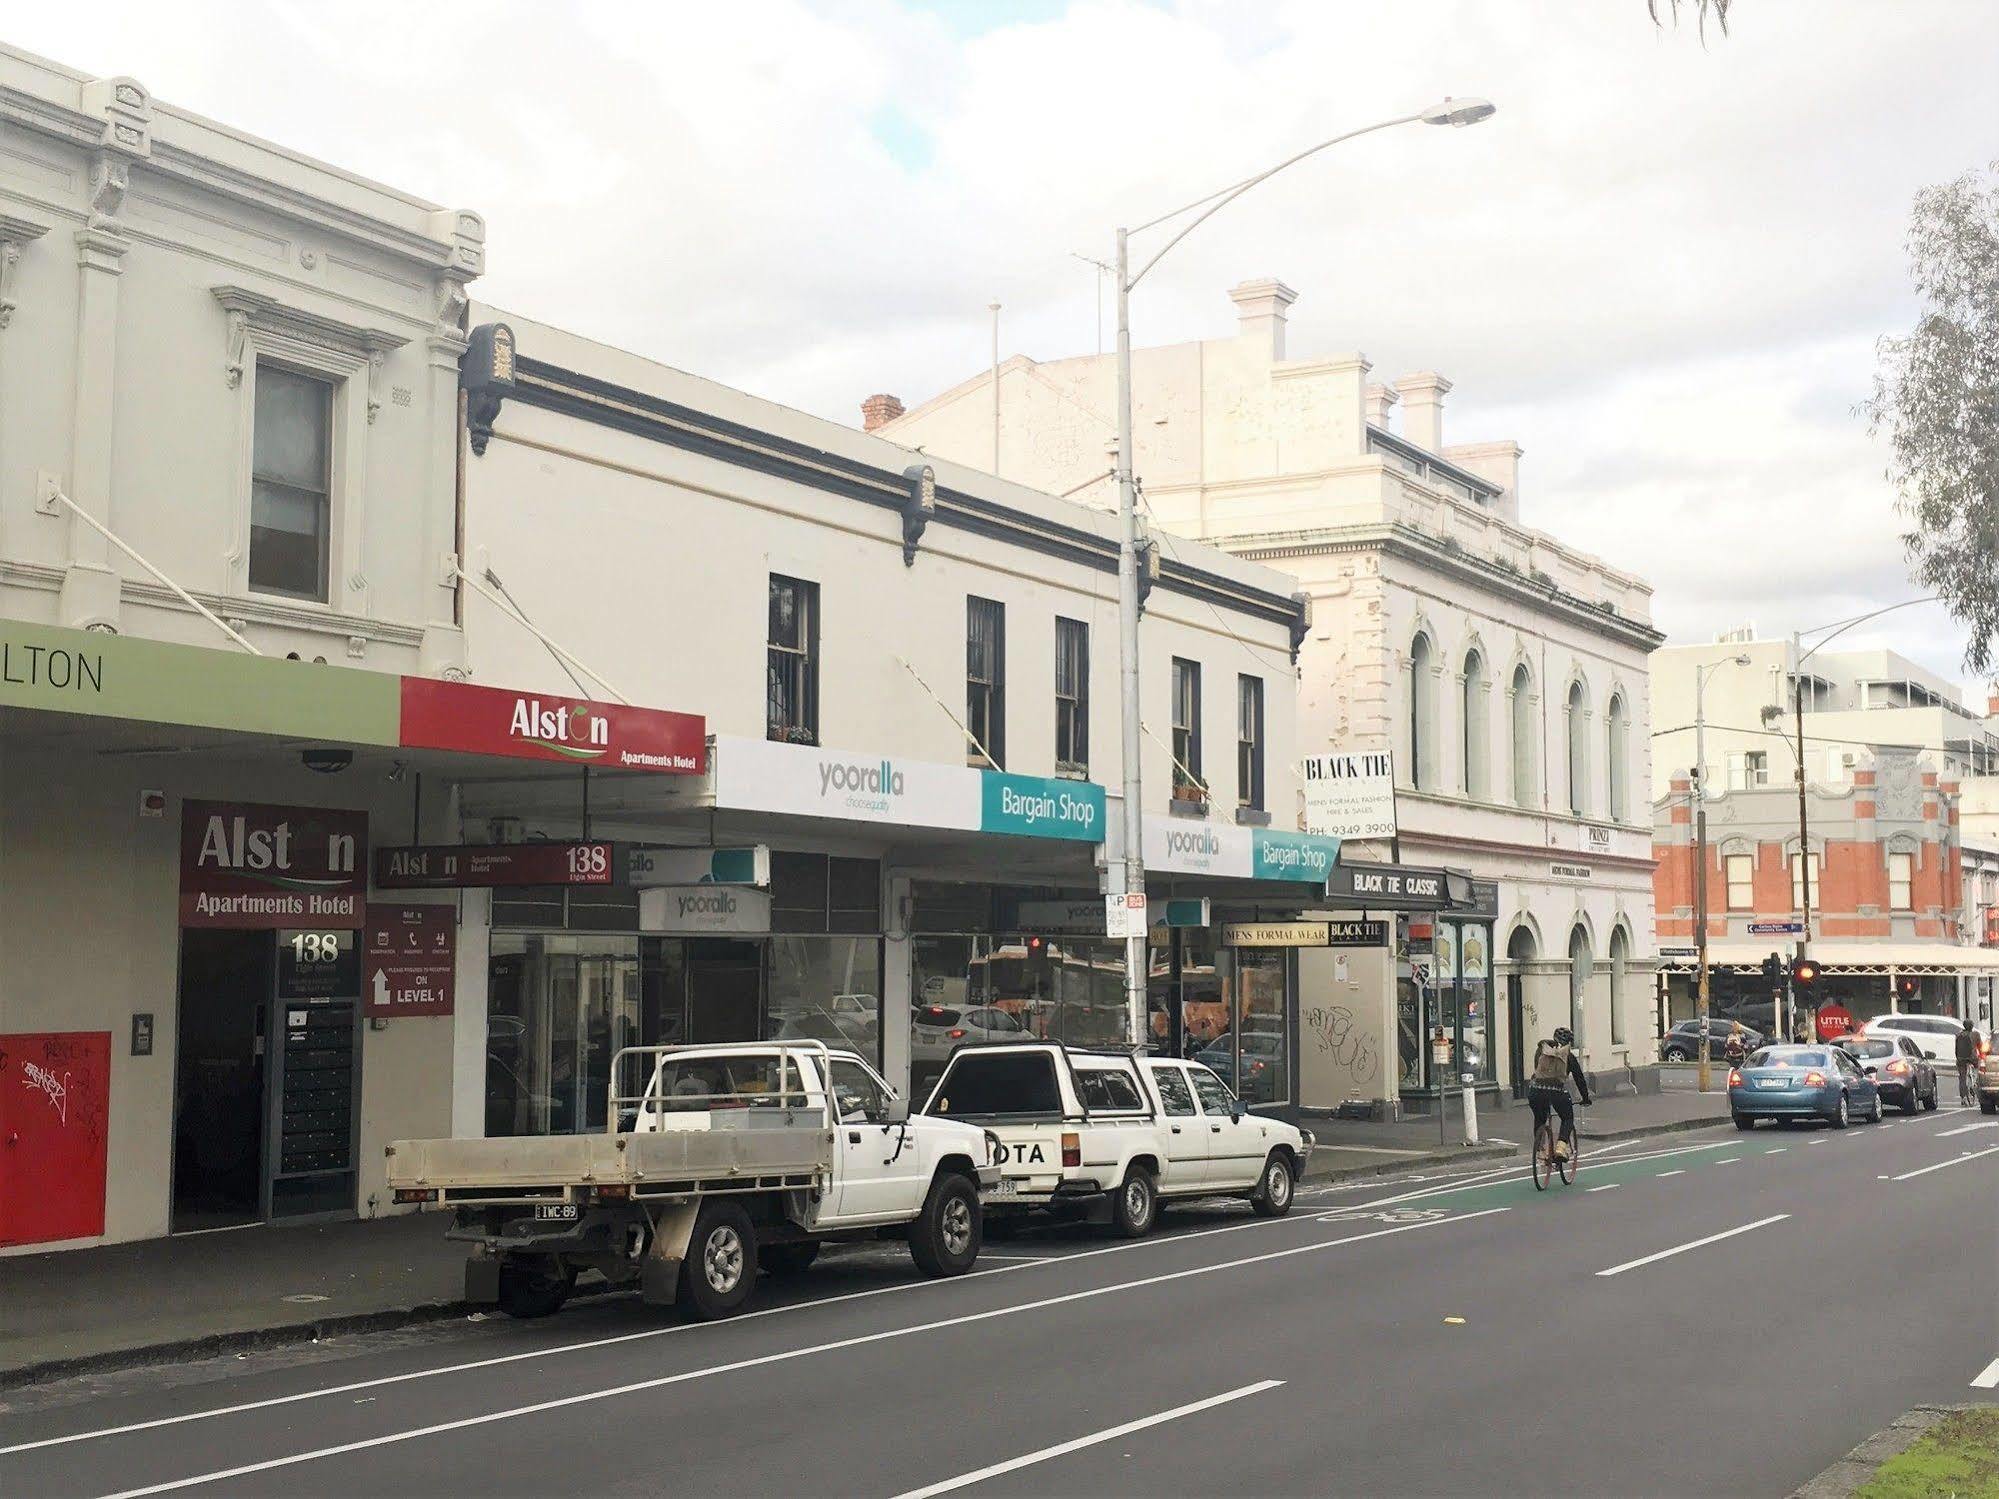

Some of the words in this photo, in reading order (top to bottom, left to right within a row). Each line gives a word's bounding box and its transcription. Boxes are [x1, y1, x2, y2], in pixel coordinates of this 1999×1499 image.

[4, 643, 102, 693] LTON
[620, 750, 672, 768] Apartments
[674, 756, 697, 770] Hotel
[1306, 757, 1358, 780] BLACK
[1362, 754, 1390, 777] TIE
[819, 760, 905, 797] yooralla
[1002, 787, 1056, 824] Bargain
[1059, 793, 1095, 829] Shop
[1332, 824, 1360, 835] 9349
[1365, 822, 1394, 833] 3900
[1166, 827, 1219, 858] yooralla
[566, 846, 607, 873] 138
[1263, 840, 1300, 870] Bargain
[1301, 844, 1327, 872] Shop
[1354, 874, 1383, 893] BLACK
[1387, 876, 1400, 893] TIE
[1406, 877, 1438, 896] CLASSIC
[196, 891, 303, 917] Apartments
[309, 895, 354, 915] Hotel
[678, 892, 737, 918] yooralla
[1227, 931, 1253, 941] MENS
[1257, 929, 1295, 940] FORMAL
[1299, 929, 1326, 940] WEAR
[1331, 923, 1362, 935] BLACK
[1364, 923, 1381, 935] TIE
[292, 934, 339, 963] 138
[416, 976, 428, 985] ON
[397, 989, 434, 1002] LEVEL
[438, 989, 444, 1002] 1
[1821, 1017, 1850, 1026] LITTLE
